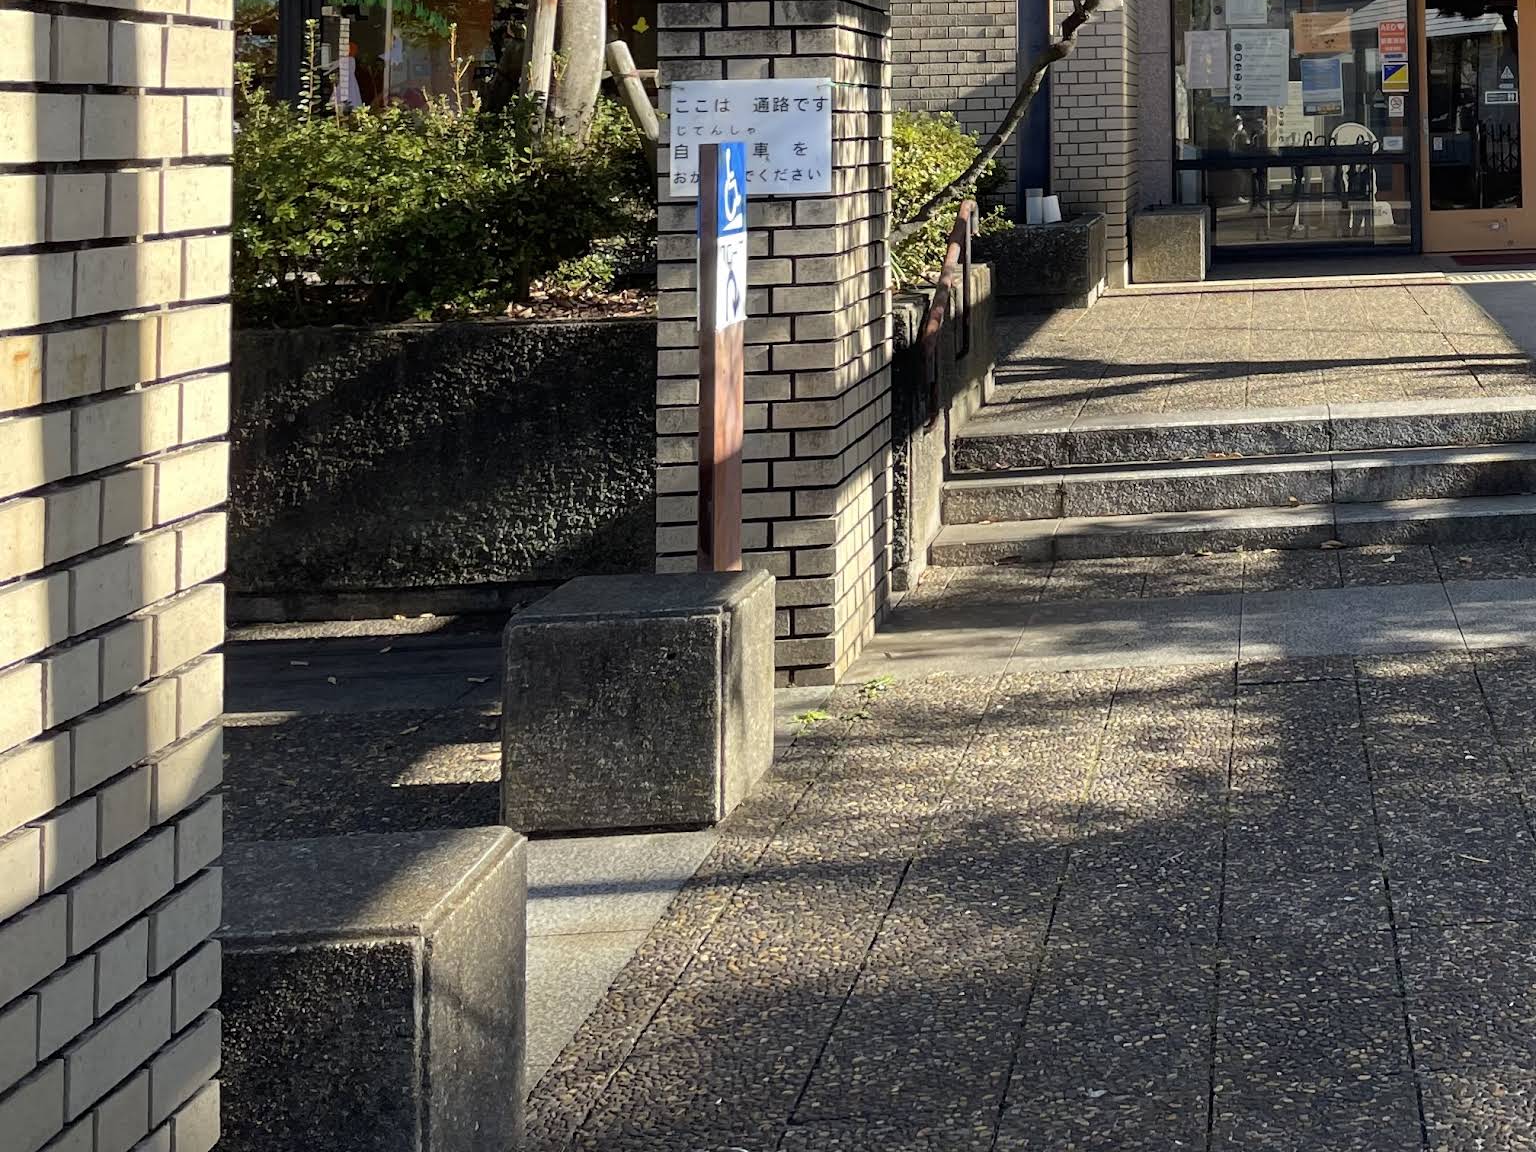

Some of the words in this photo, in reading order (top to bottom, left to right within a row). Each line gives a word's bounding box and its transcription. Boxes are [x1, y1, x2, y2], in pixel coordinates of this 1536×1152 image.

[675, 97, 732, 114] ここは
[752, 96, 829, 114] 通路です
[676, 125, 757, 137] じてんしゃ
